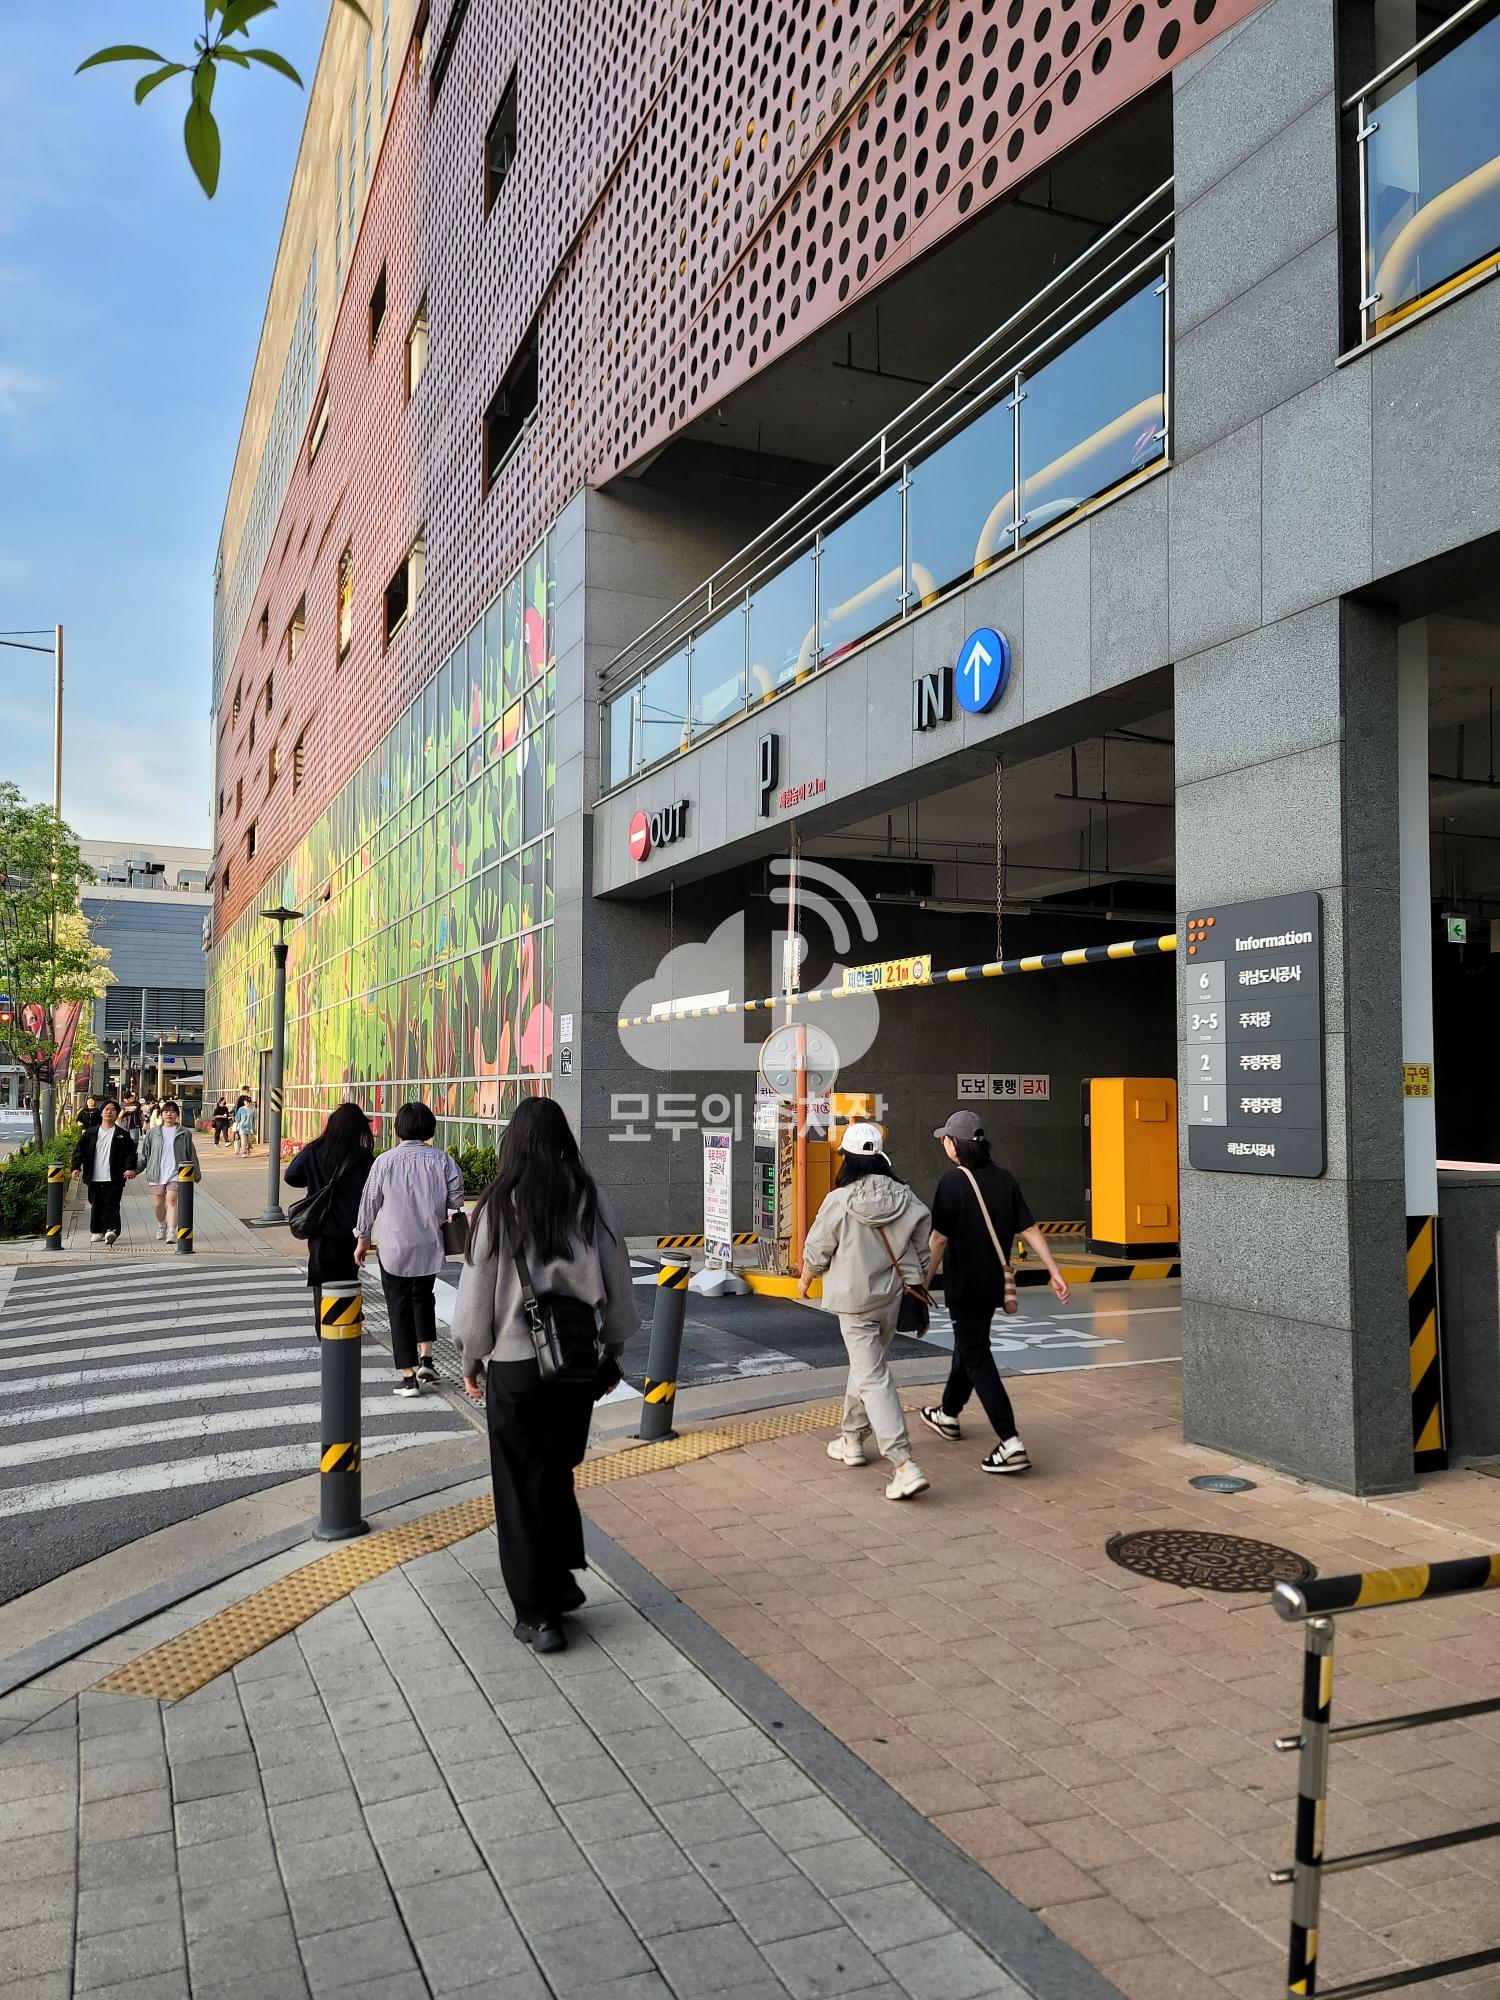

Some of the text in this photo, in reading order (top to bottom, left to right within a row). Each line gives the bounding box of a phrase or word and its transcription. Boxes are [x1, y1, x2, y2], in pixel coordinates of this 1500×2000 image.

[912, 667, 952, 731] IN
[758, 733, 779, 817] P
[779, 778, 826, 809] 제한높이 2.1m
[651, 799, 689, 847] OUT
[1235, 930, 1312, 952] Information
[848, 967, 882, 989] 제한높이
[1199, 965, 1302, 989] 6 하남도시공사
[1191, 1011, 1271, 1031] 3~5 주차장
[1200, 1053, 1282, 1071] 2 주렁주렁
[1402, 1066, 1430, 1083] 구역
[961, 1078, 1047, 1095] 도보 통행 금지
[1202, 1094, 1282, 1114] 1 주렁주렁
[1226, 1142, 1275, 1157] 하남도시공사
